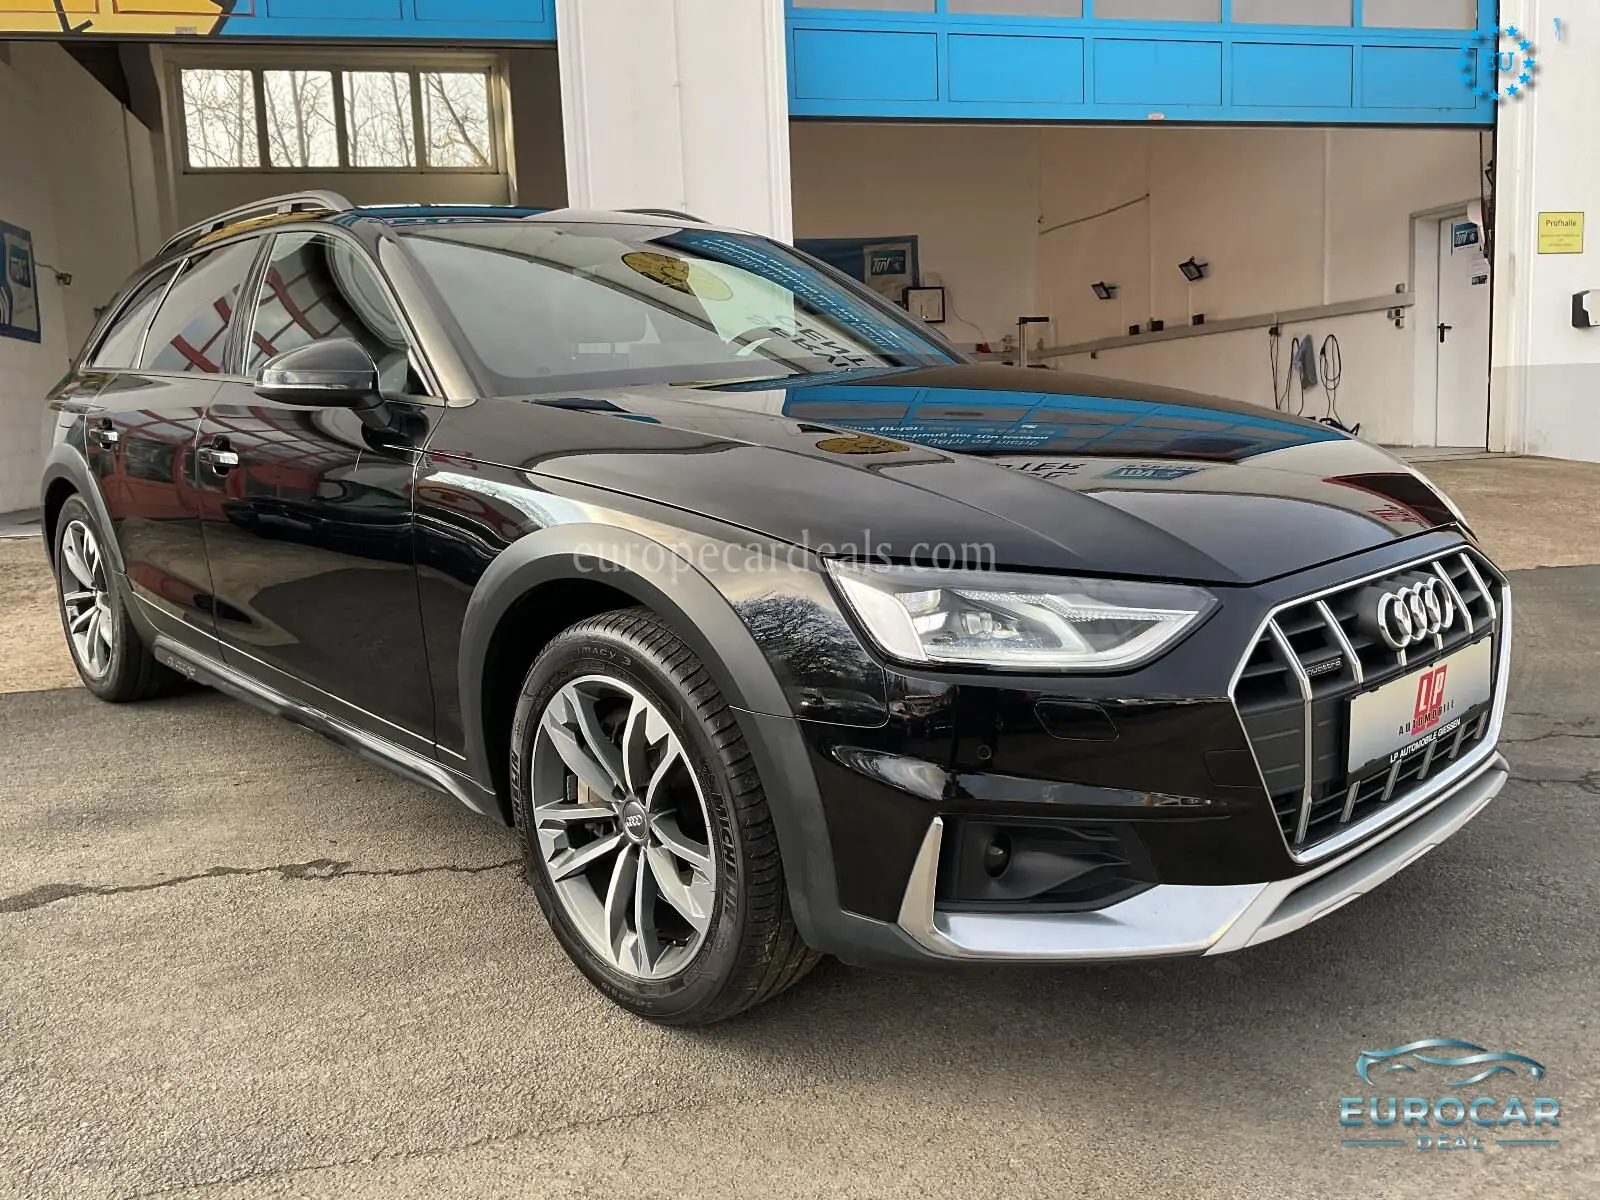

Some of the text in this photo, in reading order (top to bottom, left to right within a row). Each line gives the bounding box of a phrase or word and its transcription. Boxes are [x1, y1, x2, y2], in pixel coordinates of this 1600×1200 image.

[1418, 671, 1445, 712] LP
[1398, 698, 1455, 736] AUTOMOBILE
[1389, 717, 1461, 764] LP AUTOMOBILE GIESSEN
[711, 790, 738, 926] MICHELIN
